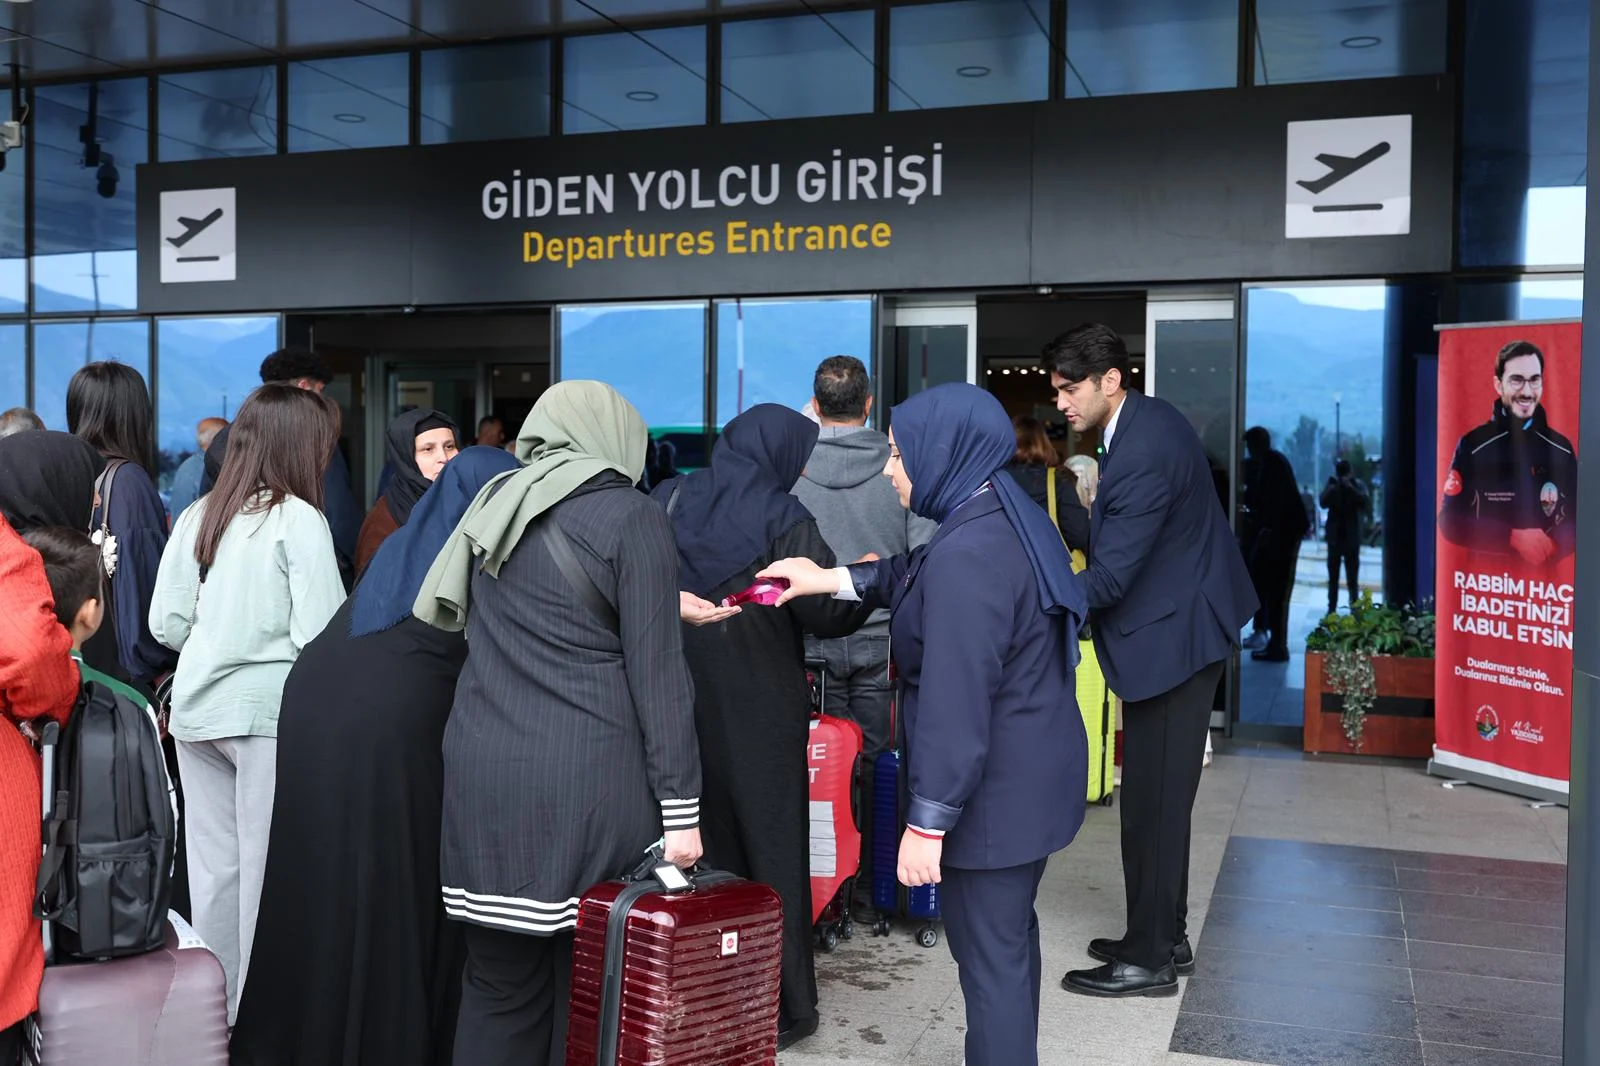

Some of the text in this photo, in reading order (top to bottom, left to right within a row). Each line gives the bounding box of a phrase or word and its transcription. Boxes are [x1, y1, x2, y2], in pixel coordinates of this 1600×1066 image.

[482, 142, 943, 220] GİDEN YOLCU GİRİŞİ
[523, 221, 892, 268] Departures Entrance
[1454, 570, 1574, 603] RABBİM HAC
[1461, 589, 1570, 626] İBADETİNİZİ
[1453, 613, 1574, 650] KABUL ETSİN
[1499, 674, 1532, 690] Bizimle
[1533, 681, 1564, 696] Olsun.
